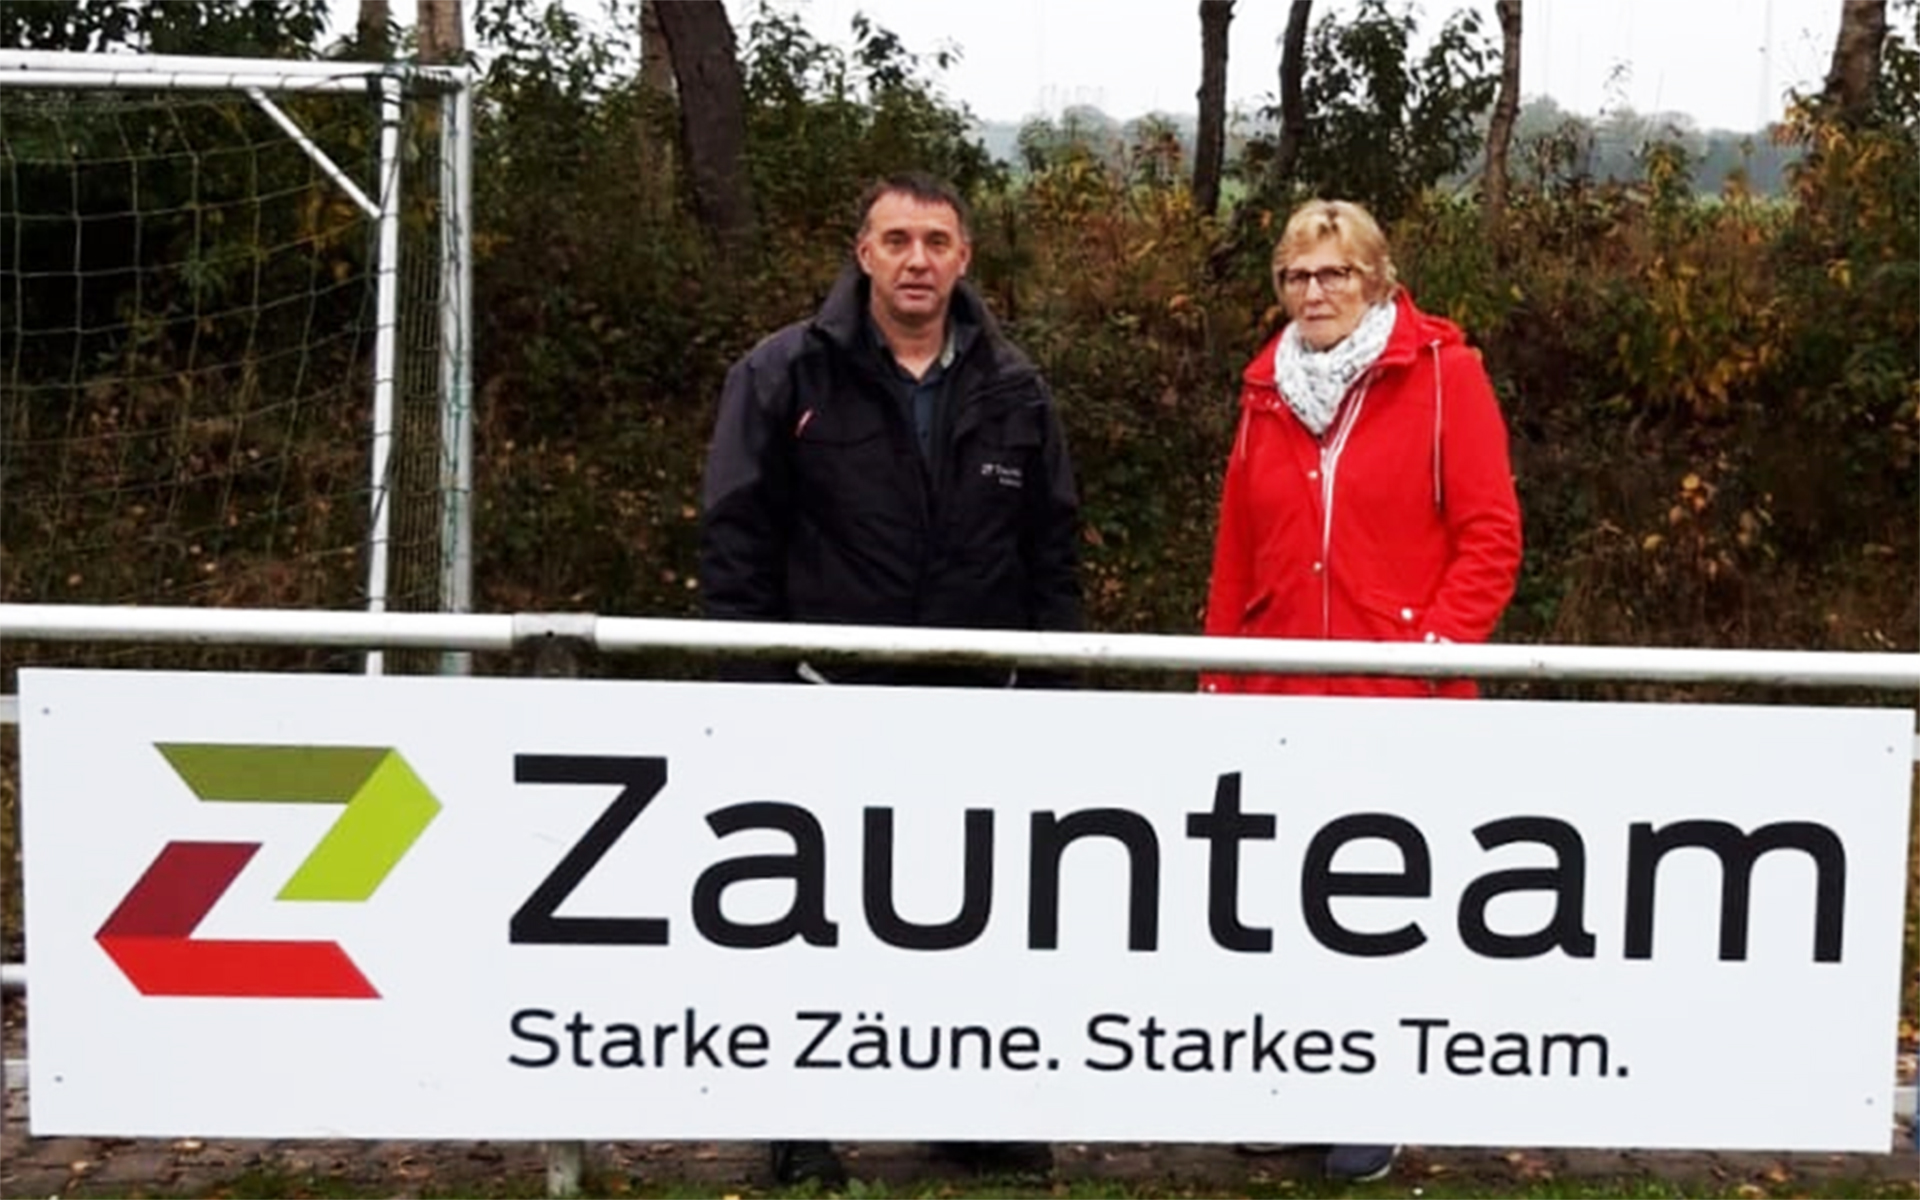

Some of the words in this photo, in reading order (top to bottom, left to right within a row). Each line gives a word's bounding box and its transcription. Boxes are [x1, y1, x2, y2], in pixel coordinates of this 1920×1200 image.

[508, 753, 1847, 965] Zaunteam
[507, 1007, 771, 1070] Starke
[793, 1010, 1060, 1072] Zäune.
[1084, 1012, 1377, 1075] Starkes
[1398, 1018, 1630, 1078] Team.
